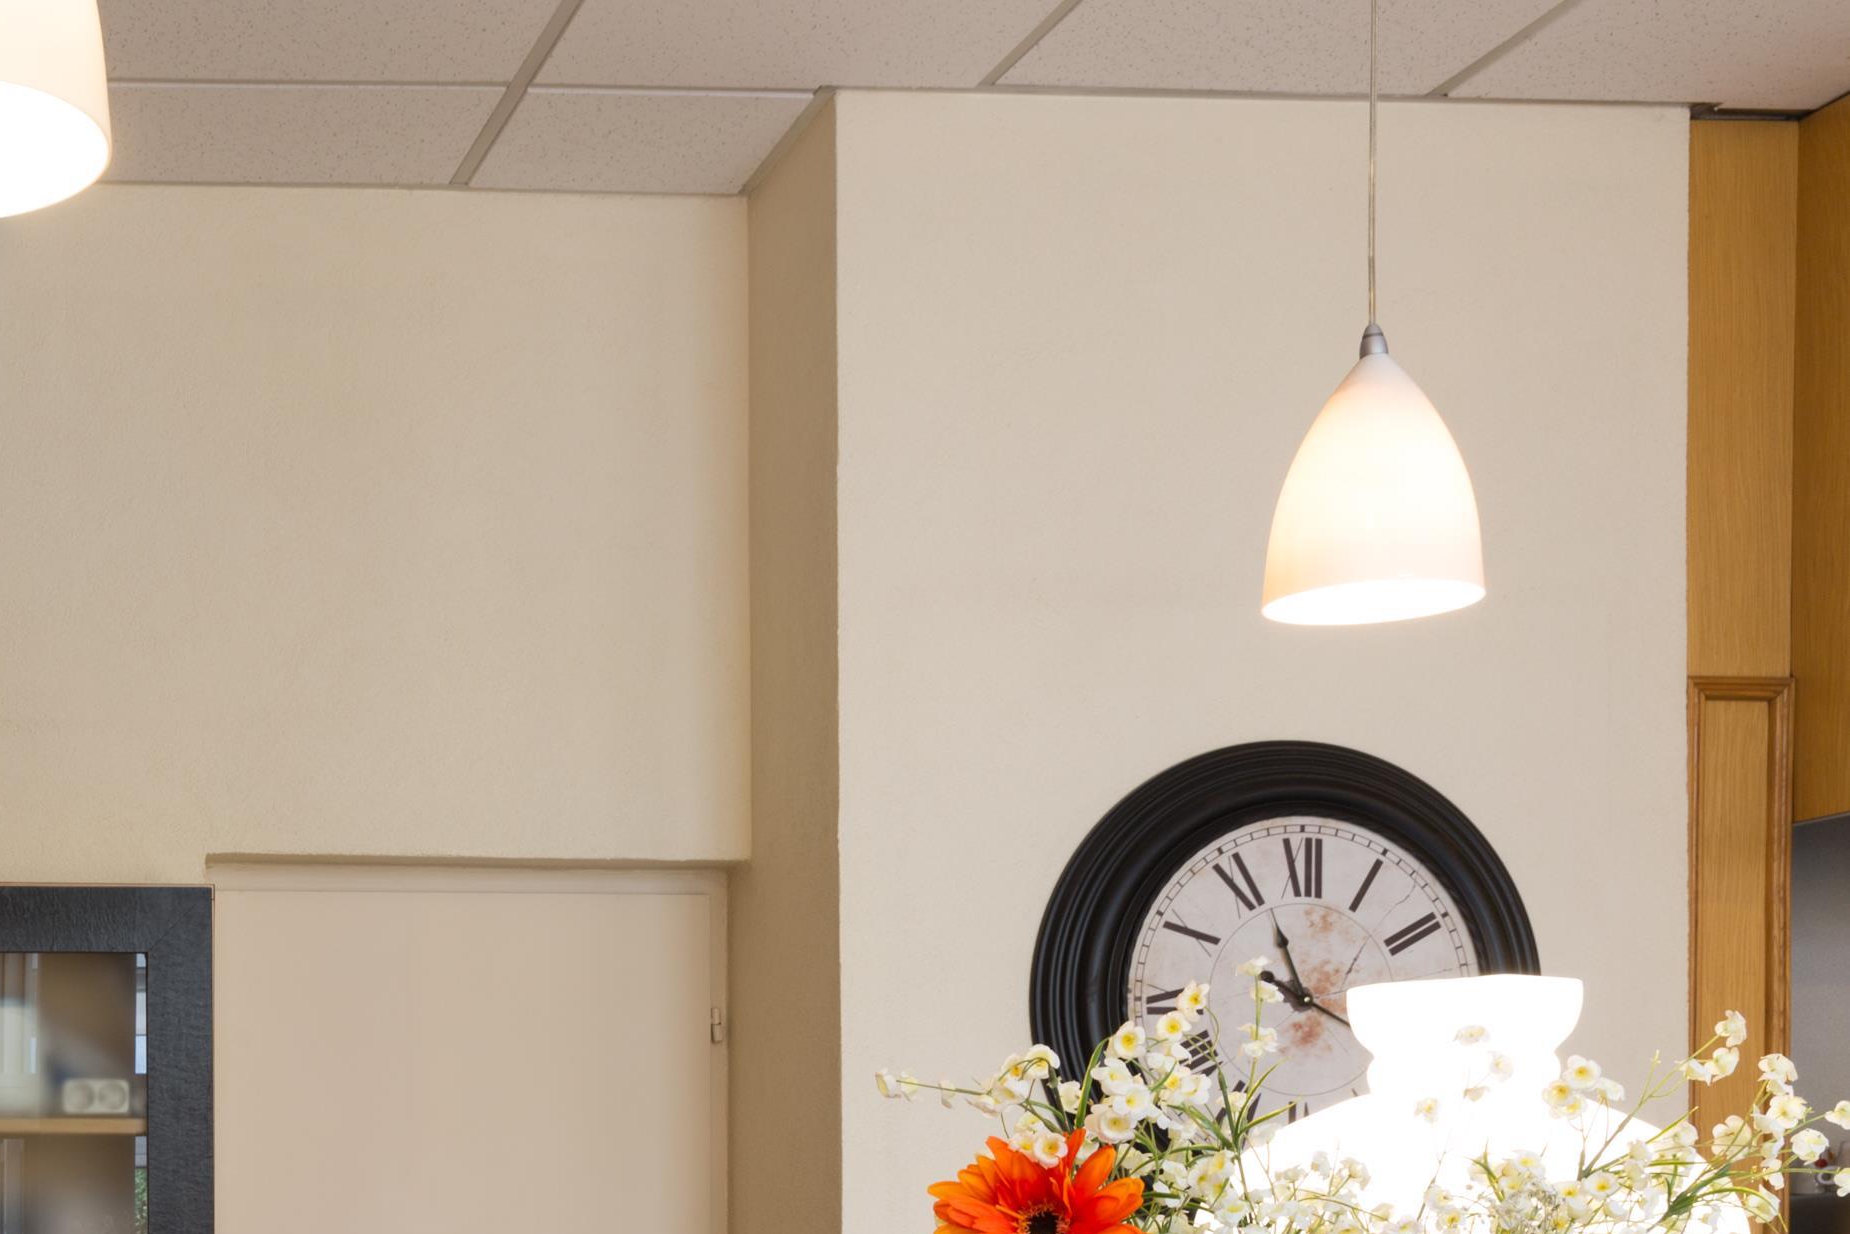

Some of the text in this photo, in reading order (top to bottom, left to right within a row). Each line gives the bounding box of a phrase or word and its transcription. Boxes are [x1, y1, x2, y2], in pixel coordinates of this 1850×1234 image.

[1212, 852, 1265, 919] XI
[1281, 837, 1323, 899] XII
[1349, 858, 1384, 912] I
[1384, 912, 1442, 956] II
